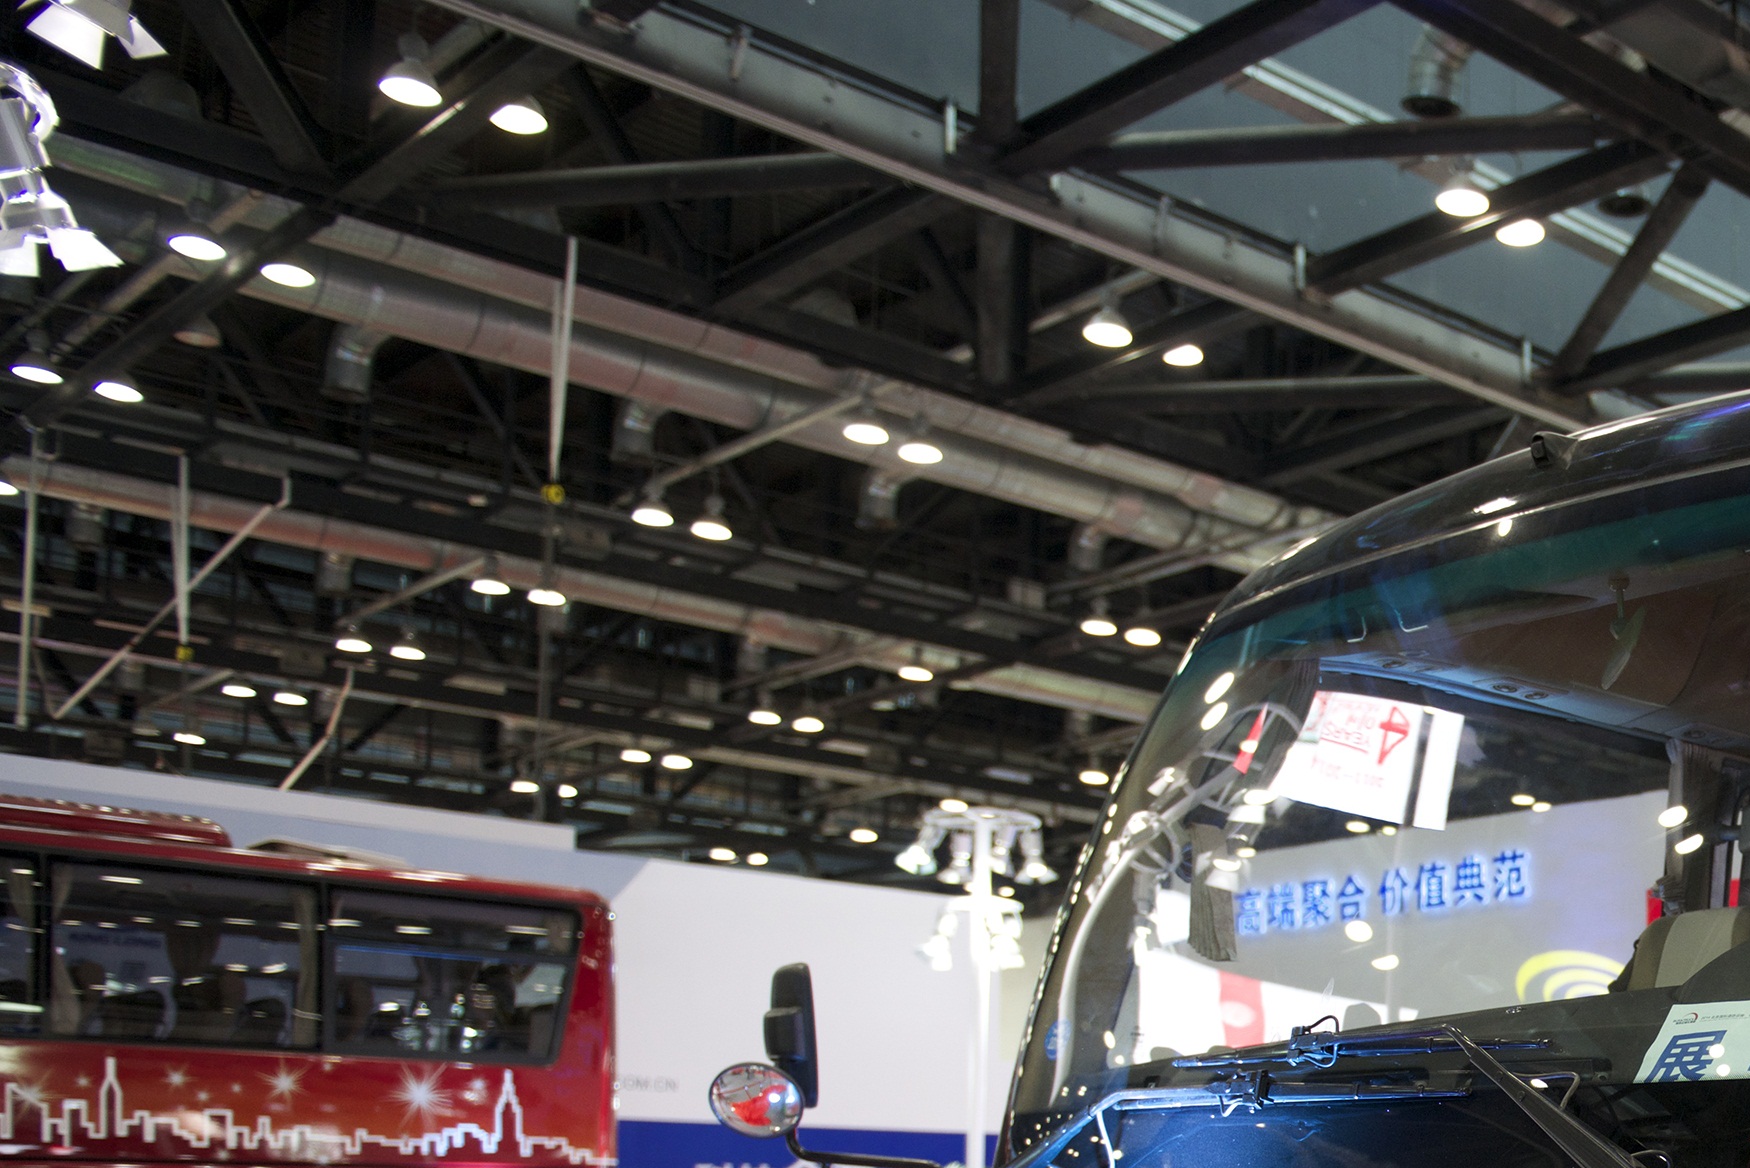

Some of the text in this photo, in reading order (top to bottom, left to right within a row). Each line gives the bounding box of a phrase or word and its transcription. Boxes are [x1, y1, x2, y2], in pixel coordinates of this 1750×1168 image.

[1235, 850, 1528, 935] 高端聚合 价值典范
